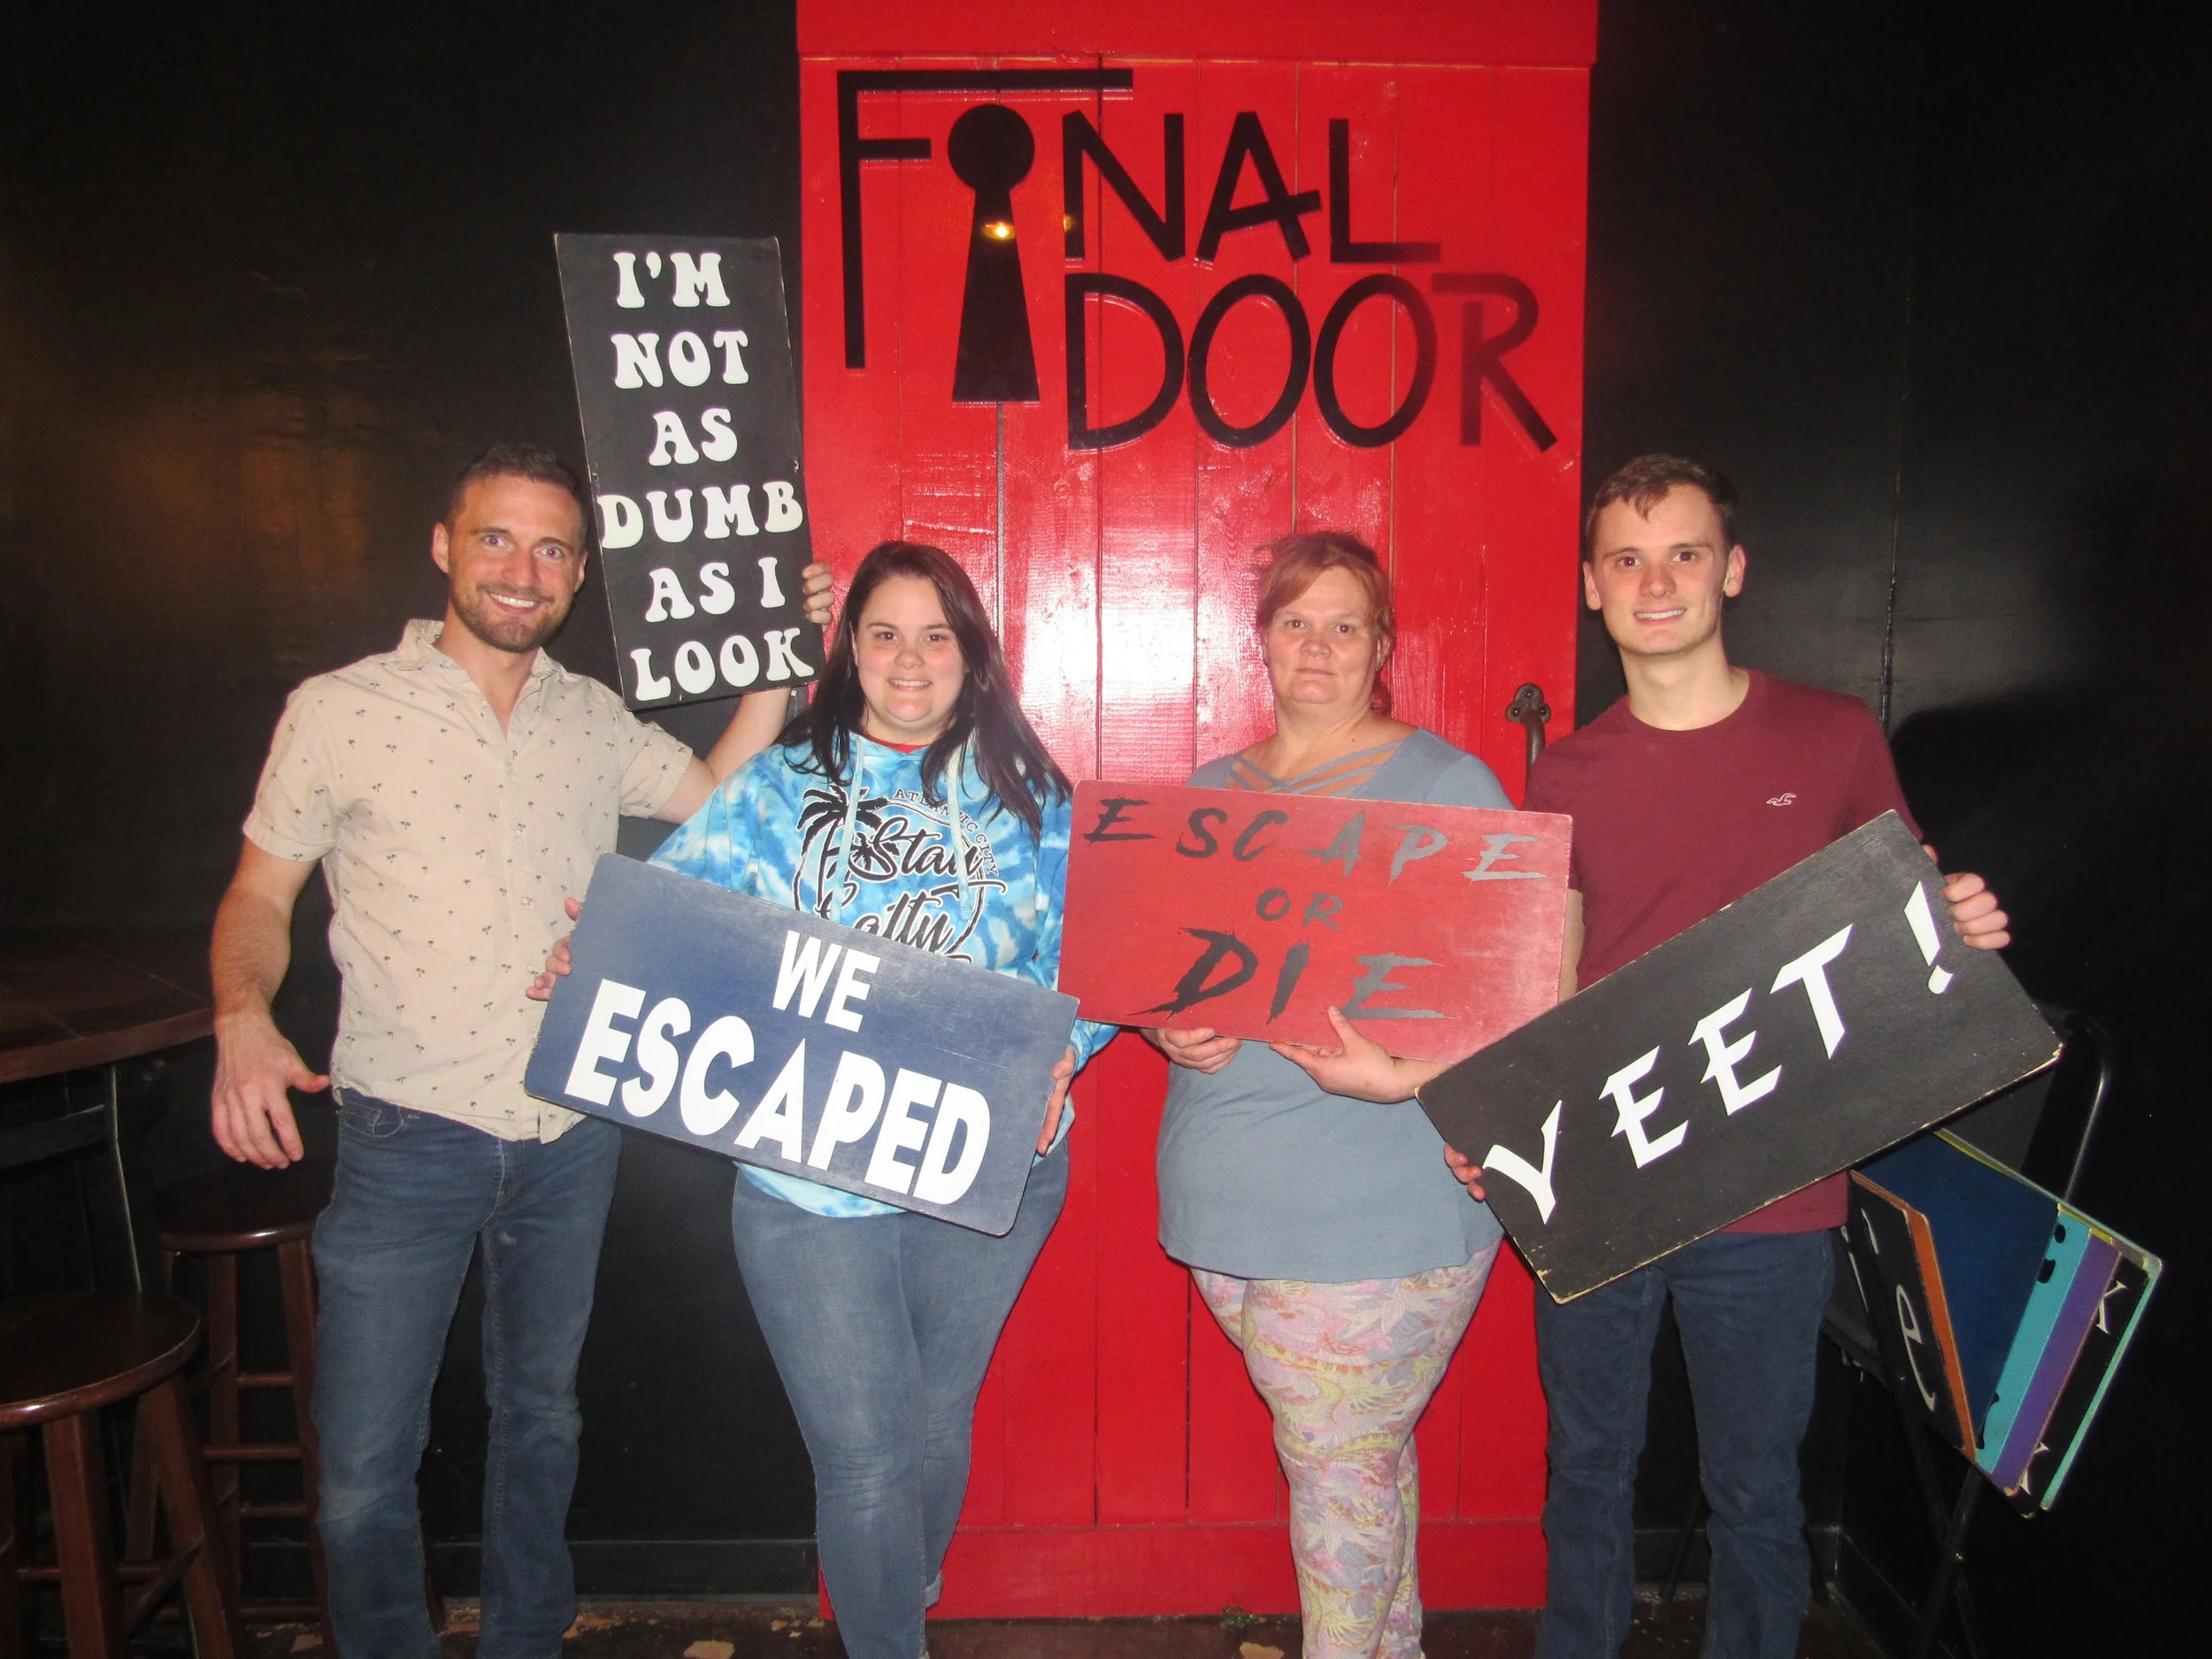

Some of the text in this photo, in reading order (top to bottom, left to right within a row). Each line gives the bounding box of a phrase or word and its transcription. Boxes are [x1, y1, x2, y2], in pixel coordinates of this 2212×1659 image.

[614, 251, 730, 308] I'M
[611, 330, 749, 388] NOT
[1064, 272, 1558, 452] DOOR
[649, 408, 737, 465] AS
[597, 481, 803, 549] DUMB
[645, 557, 785, 622] AS I
[631, 627, 814, 701] LOOK
[894, 787, 999, 877] ATLNIC CITY
[1081, 796, 1550, 885] ESCAPE
[1256, 888, 1342, 931] OR
[772, 930, 880, 1033] WE
[1127, 926, 1458, 1026] DIE
[565, 978, 991, 1205] ESCAPED
